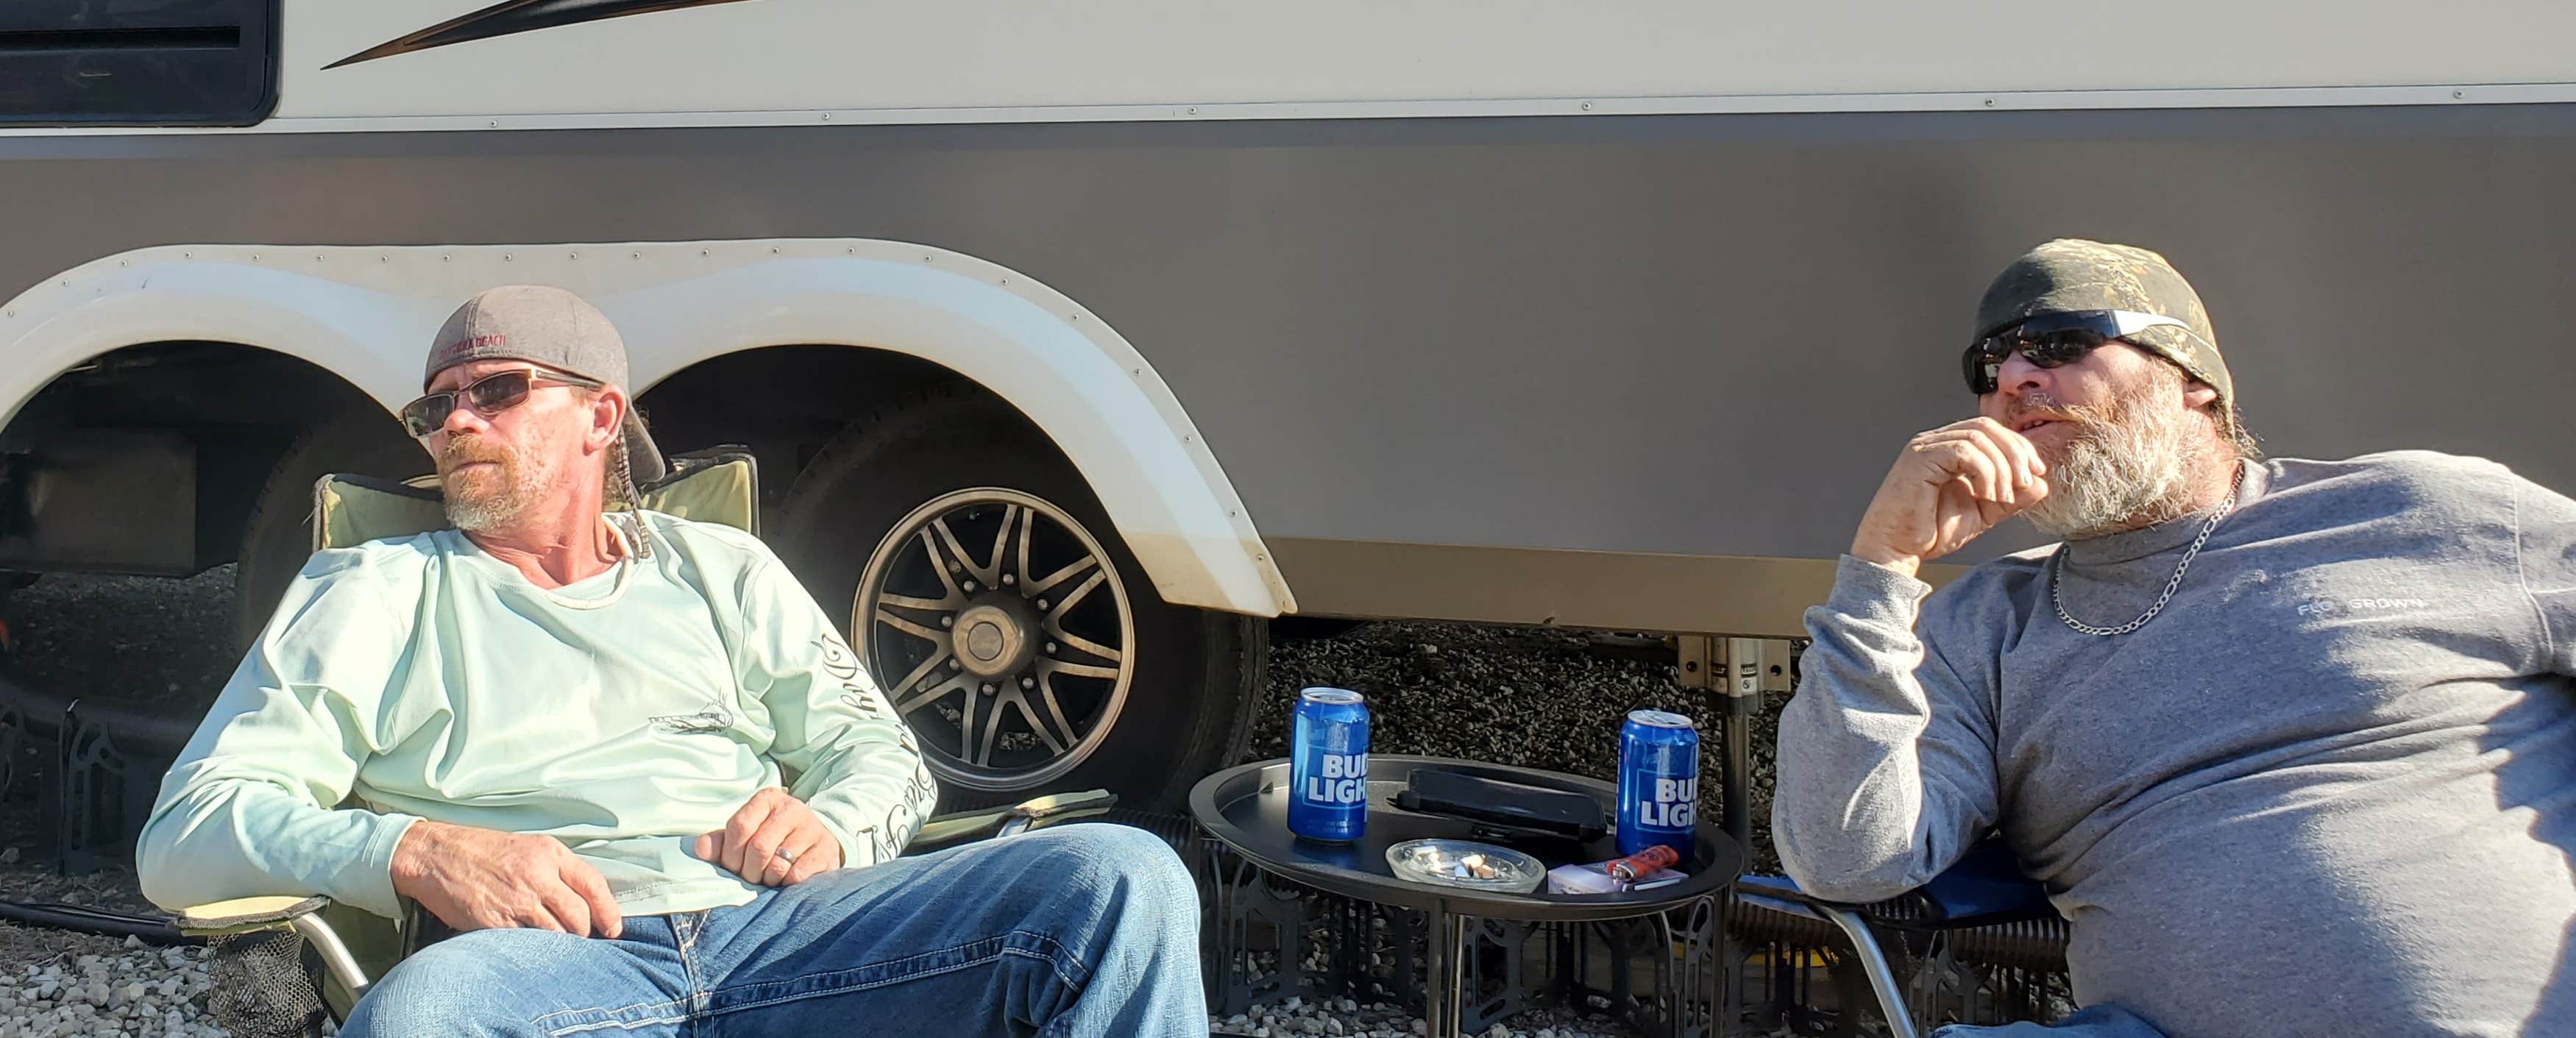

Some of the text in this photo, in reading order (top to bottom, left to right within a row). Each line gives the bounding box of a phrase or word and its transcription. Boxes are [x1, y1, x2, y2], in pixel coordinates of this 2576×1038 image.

[475, 335, 506, 348] BEACH
[2297, 597, 2424, 616] FLO GROWN
[1308, 776, 1366, 803] LIGH
[1656, 777, 1698, 803] BU
